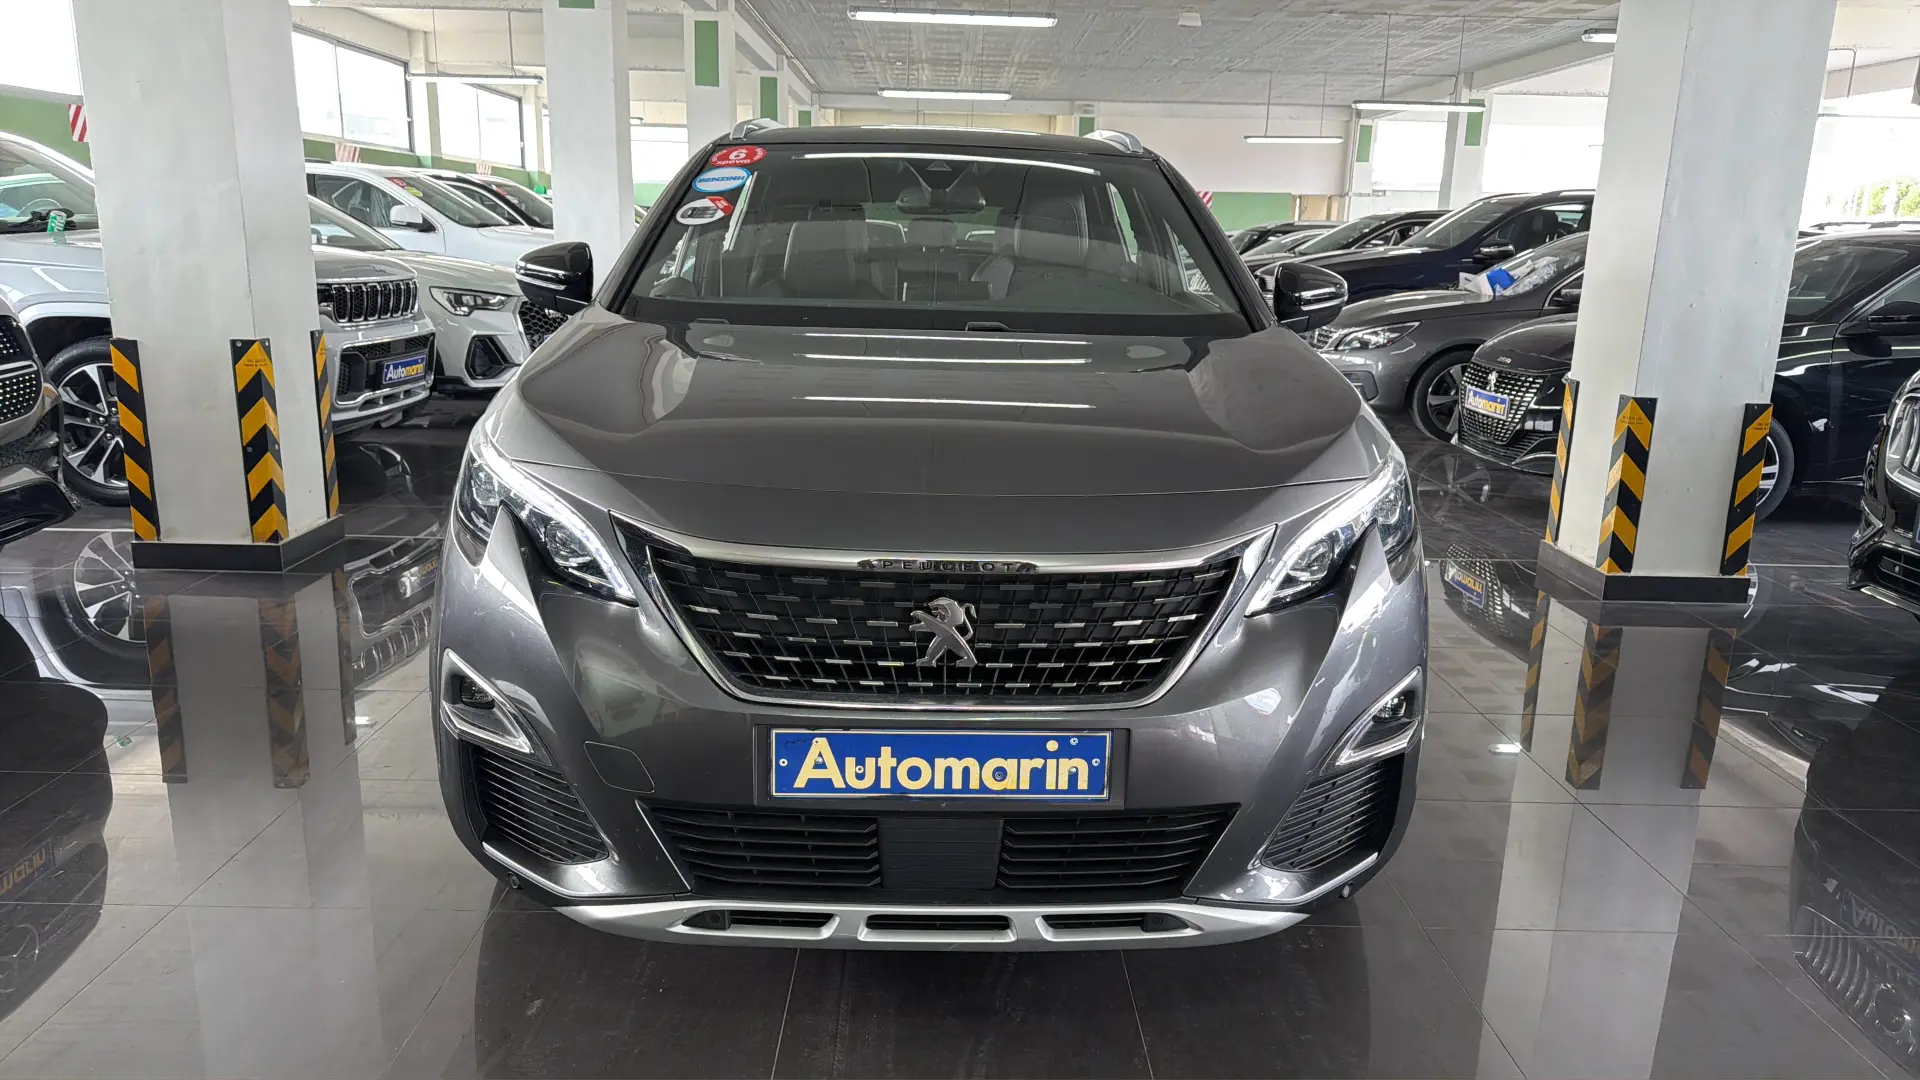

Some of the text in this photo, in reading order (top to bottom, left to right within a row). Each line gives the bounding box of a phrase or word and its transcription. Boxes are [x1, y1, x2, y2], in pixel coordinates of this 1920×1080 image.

[728, 148, 749, 160] 6
[385, 358, 425, 381] Automarin
[881, 561, 1016, 572] PEUGEOT
[793, 737, 1089, 790] Automarin
